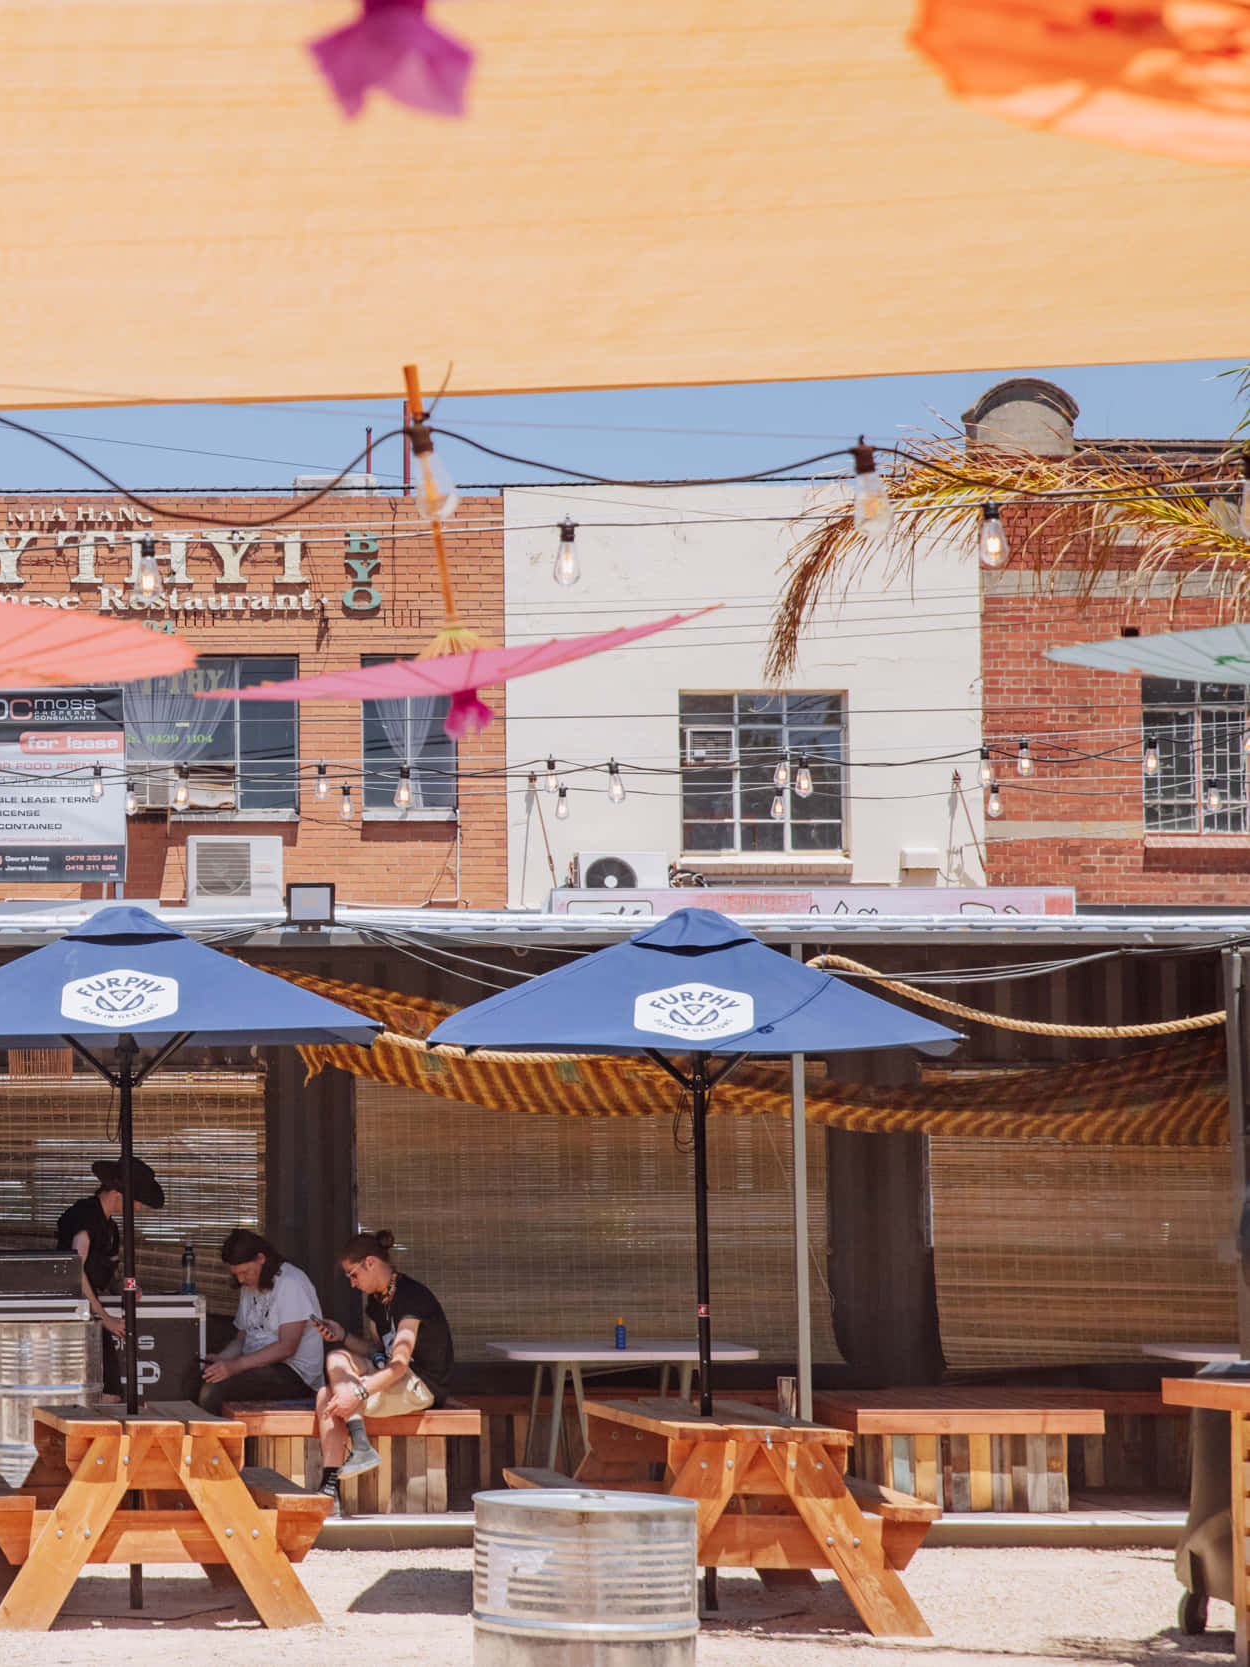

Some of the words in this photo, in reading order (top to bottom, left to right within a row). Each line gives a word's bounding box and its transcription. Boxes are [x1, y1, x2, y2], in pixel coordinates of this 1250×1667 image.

[57, 530, 261, 584] THY
[99, 586, 315, 610] Restaurant
[34, 698, 97, 710] moss
[28, 735, 59, 749] for
[66, 735, 119, 749] lease
[21, 796, 58, 804] LEASE
[61, 796, 100, 804] TERMS
[76, 976, 166, 998] FURPHY
[649, 990, 741, 1011] FURPHY
